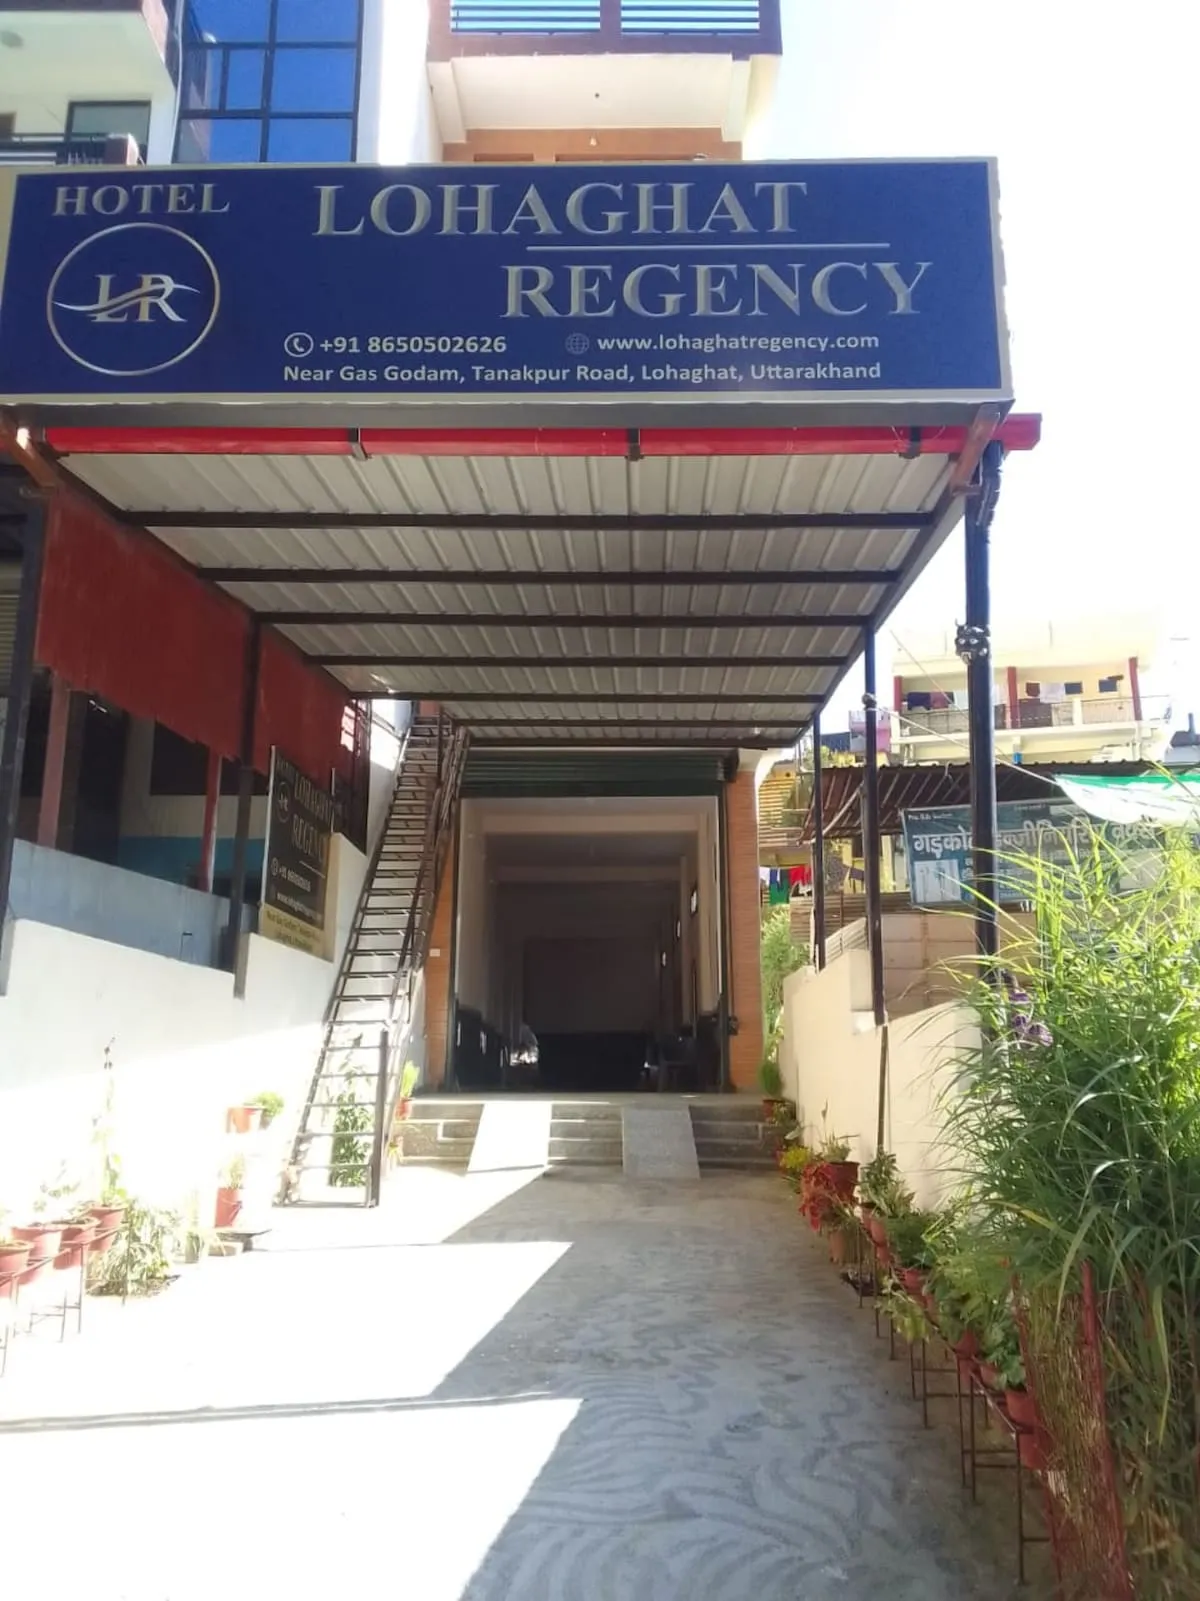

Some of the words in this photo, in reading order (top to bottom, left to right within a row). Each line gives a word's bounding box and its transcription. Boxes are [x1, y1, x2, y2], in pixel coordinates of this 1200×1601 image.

[52, 183, 230, 216] HOTEL
[312, 181, 809, 237] LOHAGHAT
[91, 273, 188, 323] LR
[500, 260, 932, 319] REGENCY
[319, 336, 361, 354] +91
[366, 335, 508, 354] 8650502626
[596, 334, 880, 354] www.lohaghatregency.com
[283, 365, 334, 382] Near
[339, 365, 378, 382] Gas
[382, 364, 466, 385] Godam,
[471, 364, 572, 386] Tanakpur
[576, 363, 636, 384] Road,
[641, 362, 745, 385] Lohaghat,
[750, 361, 882, 382] Uttarakhand
